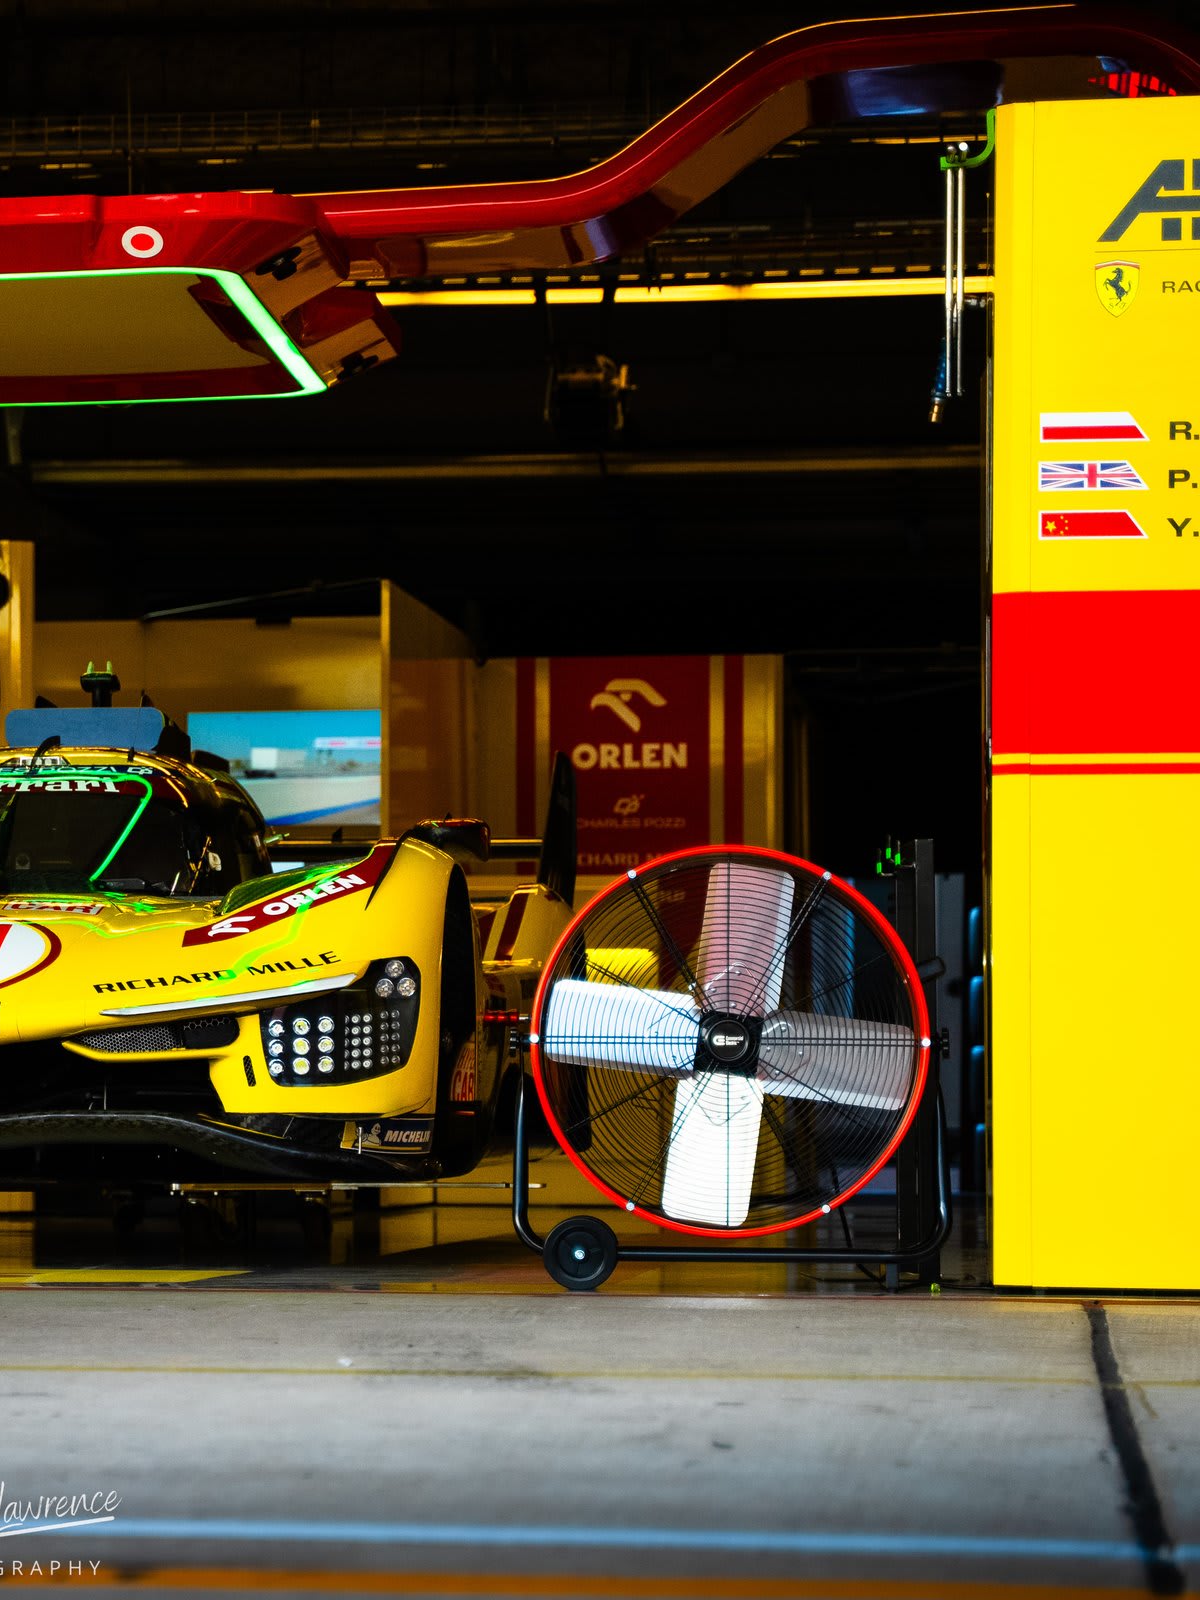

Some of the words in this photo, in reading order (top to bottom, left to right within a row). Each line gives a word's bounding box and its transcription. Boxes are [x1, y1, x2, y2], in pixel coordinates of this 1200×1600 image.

[1169, 421, 1200, 440] R.
[1168, 469, 1198, 489] P.
[1166, 517, 1200, 537] Y.
[571, 742, 688, 770] ORLEN
[262, 873, 367, 915] ORLEN
[93, 969, 238, 994] RICHARD
[247, 951, 342, 976] MILLE
[384, 1130, 432, 1144] MICHELIN
